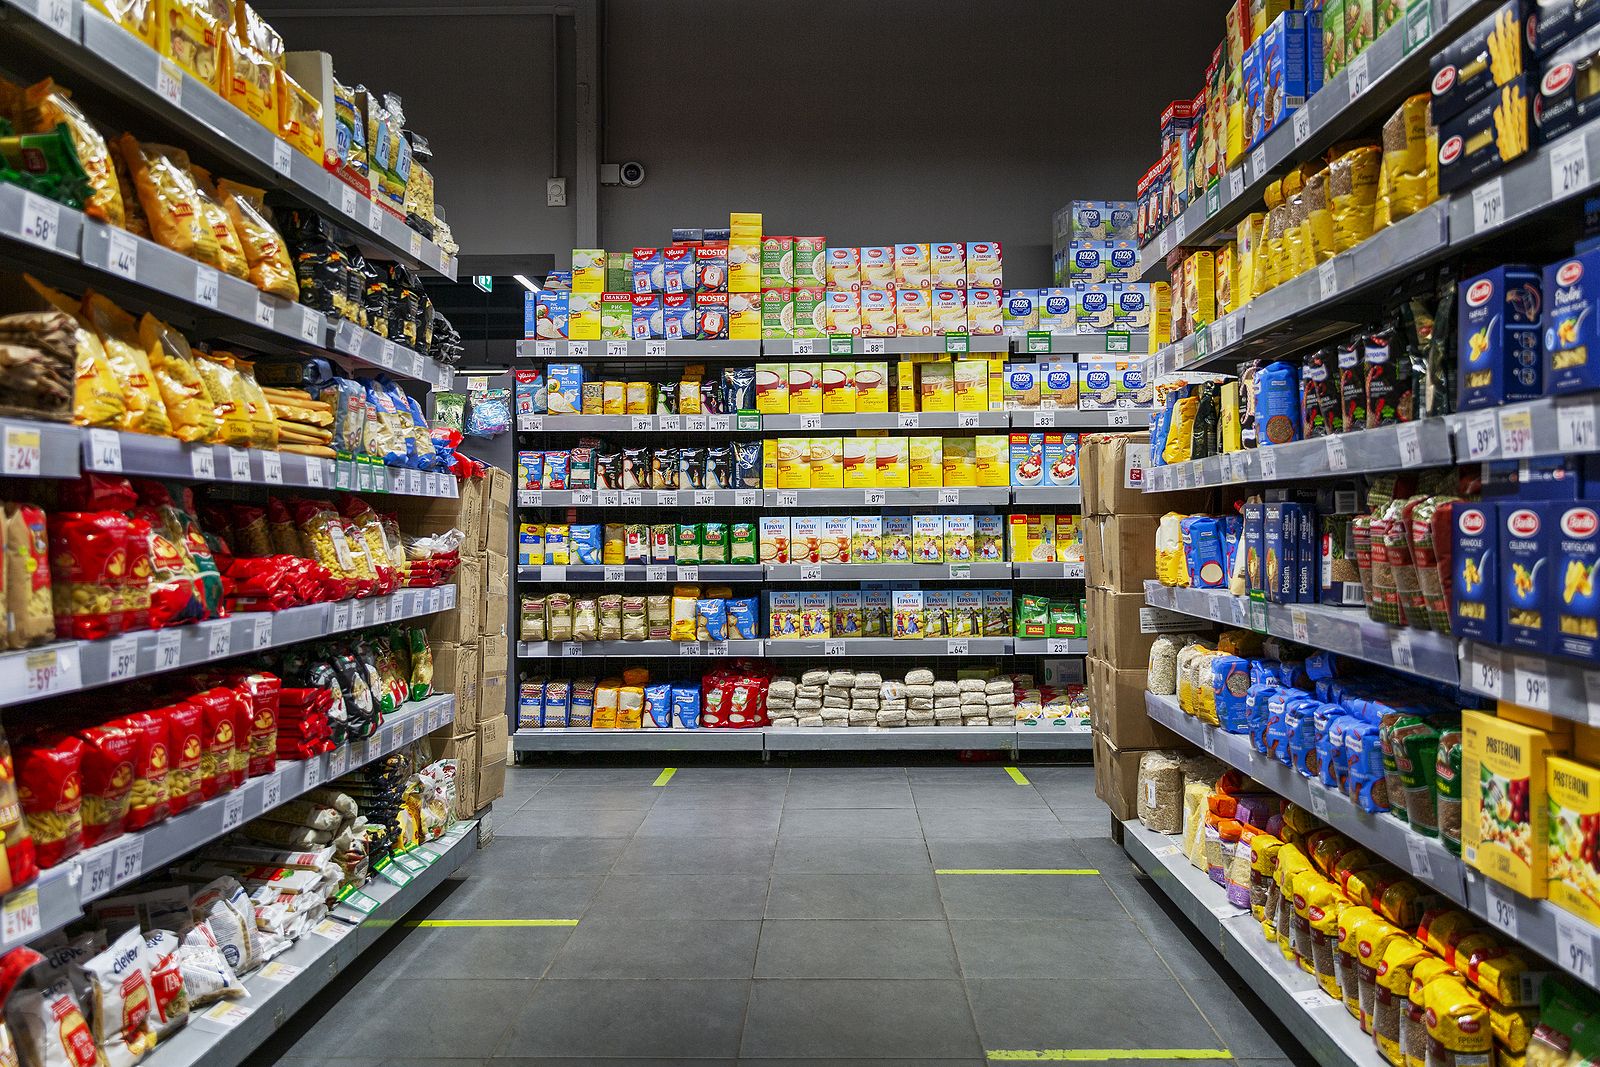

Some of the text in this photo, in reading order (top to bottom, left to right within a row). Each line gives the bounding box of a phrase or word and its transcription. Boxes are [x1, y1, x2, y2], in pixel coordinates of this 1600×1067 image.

[1079, 251, 1097, 260] 1928
[1114, 251, 1132, 259] 1928
[1086, 294, 1104, 303] 1928
[1124, 293, 1141, 302] 1928
[1012, 299, 1029, 307] 1928
[1049, 298, 1067, 306] 1928
[1013, 374, 1030, 382] 1928
[1051, 373, 1068, 381] 1928
[1090, 372, 1107, 380] 1928
[1486, 736, 1521, 764] PASTERONI
[1554, 772, 1589, 799] PASTERONI
[114, 945, 139, 974] clever
